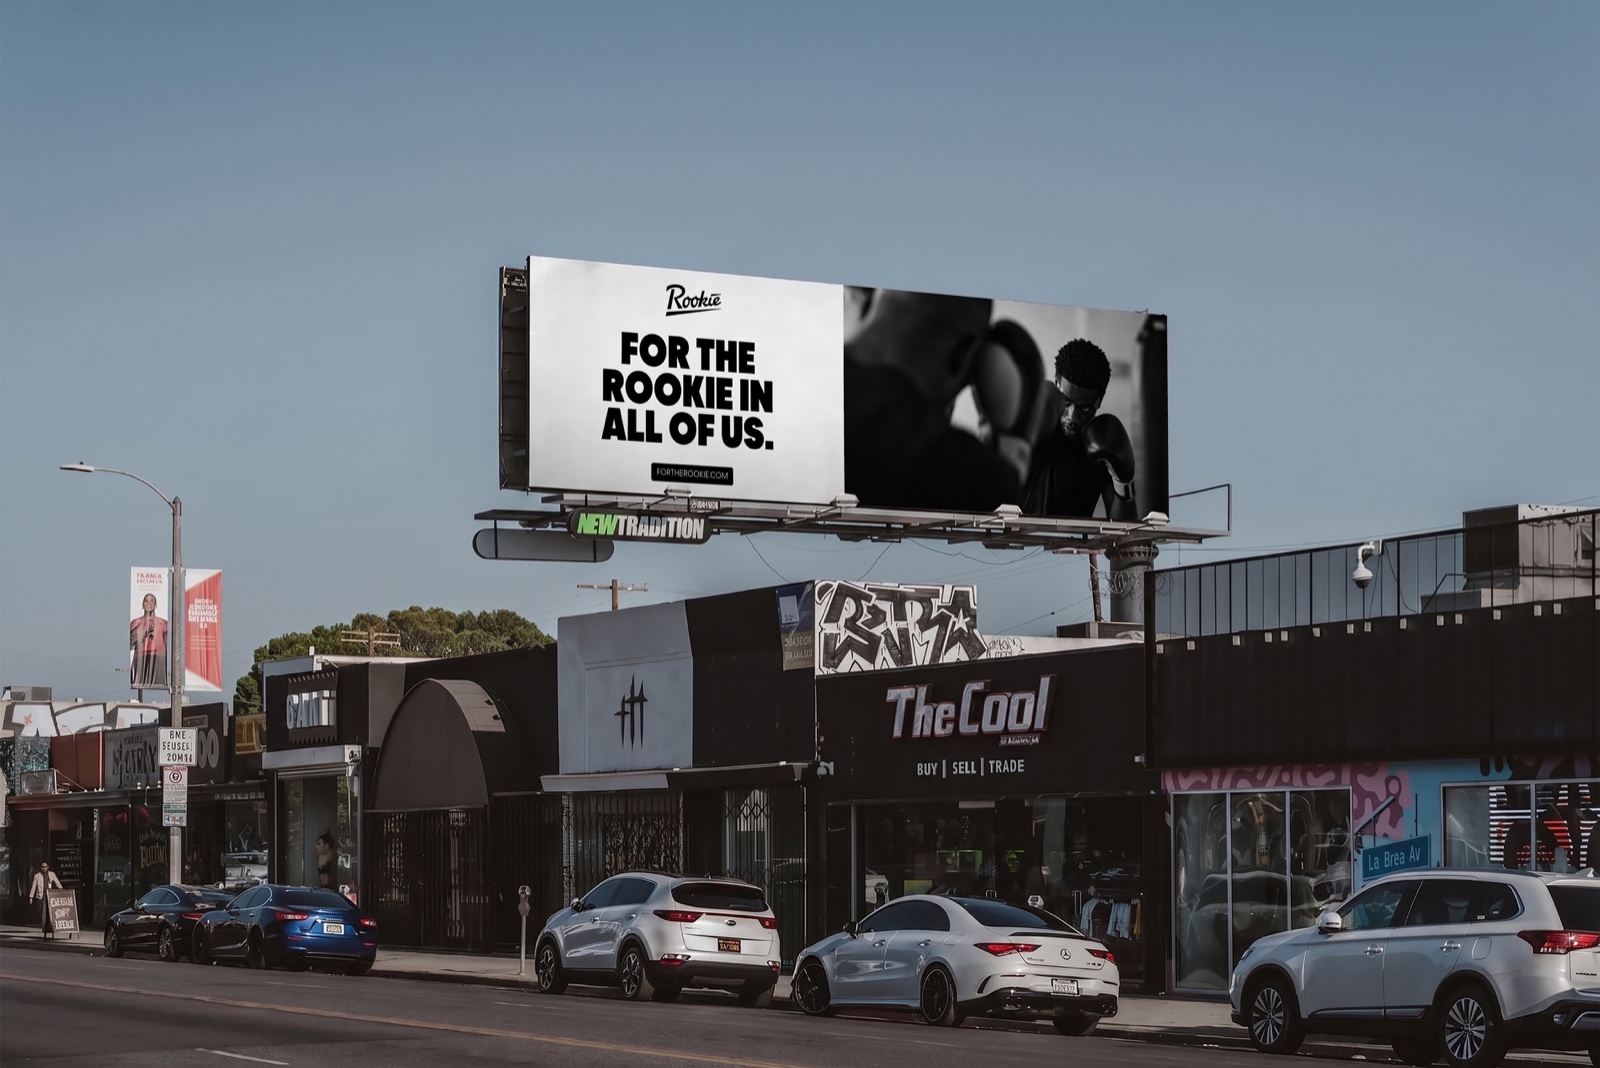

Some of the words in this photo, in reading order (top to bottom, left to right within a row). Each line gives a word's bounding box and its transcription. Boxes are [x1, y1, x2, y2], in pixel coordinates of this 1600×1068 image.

[665, 284, 722, 312] Rookie
[621, 331, 690, 370] FOR
[696, 337, 756, 374] THE
[602, 368, 734, 411] ROOKIE
[739, 379, 774, 413] IN
[601, 407, 663, 444] ALL
[669, 411, 716, 447] OF
[721, 416, 774, 450] US.
[656, 467, 729, 481] FORTHEROOKIE.COM
[886, 684, 956, 738] The
[959, 674, 1055, 736] Cool
[917, 762, 938, 776] BUY
[952, 761, 977, 774] SELL
[989, 759, 1025, 773] TRADE
[1368, 854, 1380, 871] La
[1384, 851, 1405, 868] Brea
[1409, 845, 1421, 862] Av
